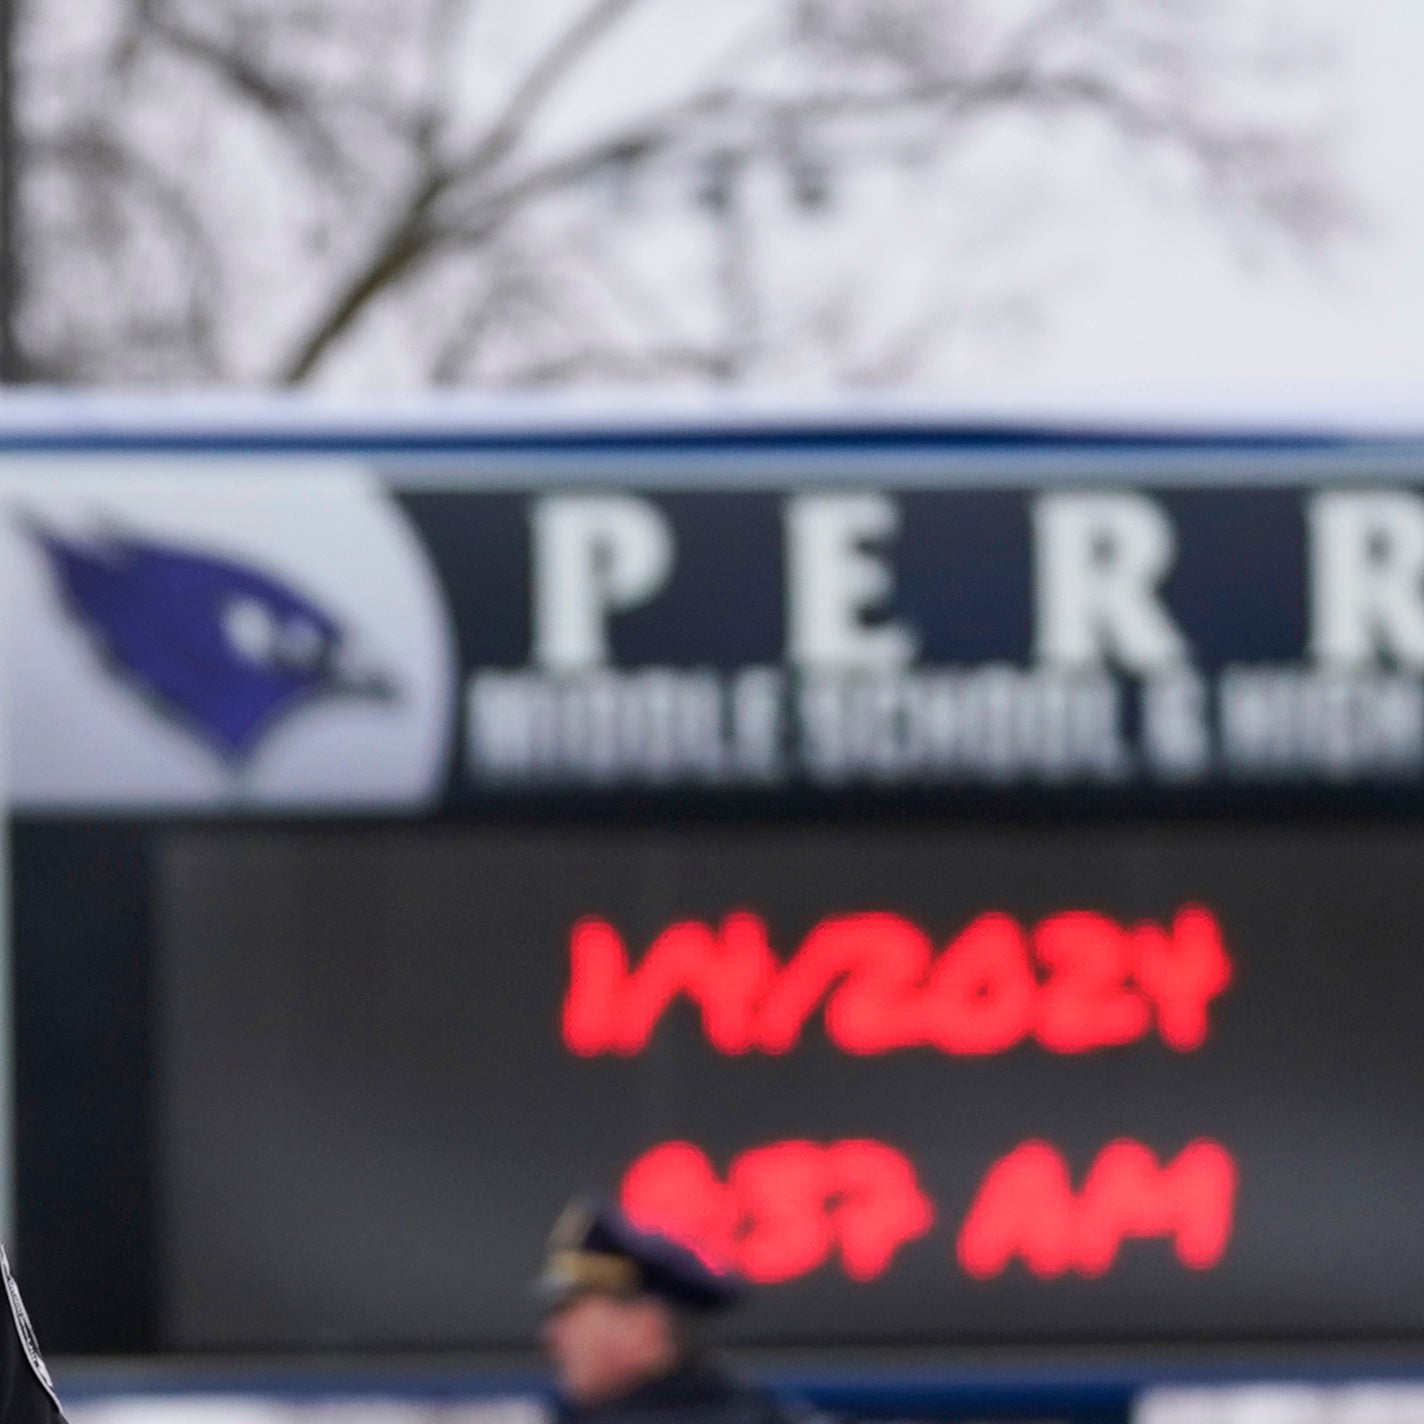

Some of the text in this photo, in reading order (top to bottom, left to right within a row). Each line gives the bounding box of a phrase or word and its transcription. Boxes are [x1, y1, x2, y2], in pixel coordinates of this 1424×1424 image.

[468, 667, 781, 780] MIDDLE
[798, 665, 1128, 782] SCHOOL
[1142, 665, 1210, 782] &
[956, 1138, 1238, 1280] AM
